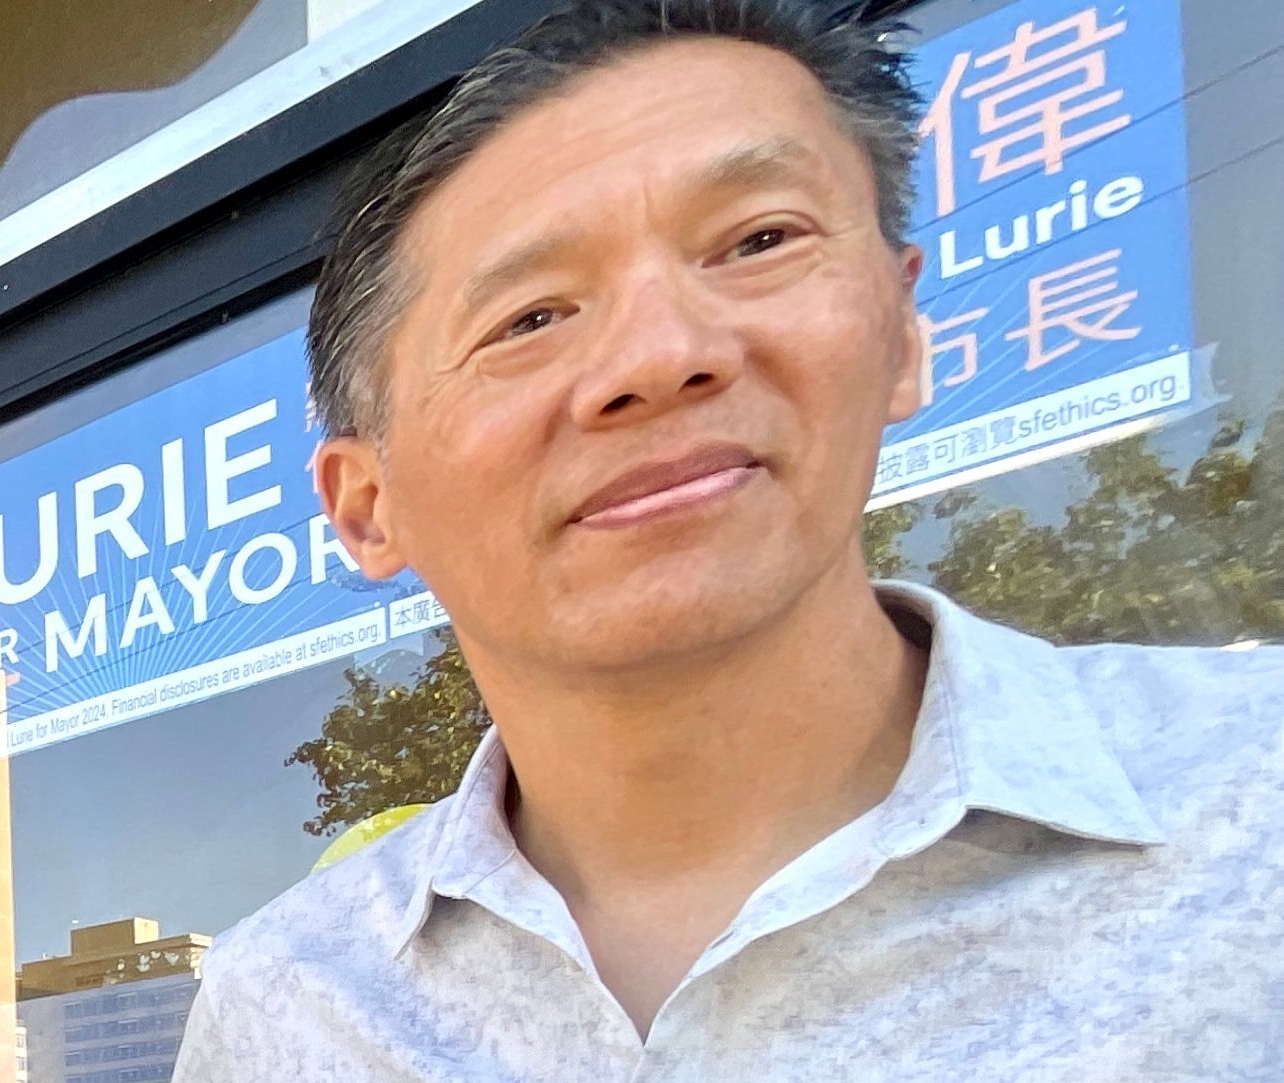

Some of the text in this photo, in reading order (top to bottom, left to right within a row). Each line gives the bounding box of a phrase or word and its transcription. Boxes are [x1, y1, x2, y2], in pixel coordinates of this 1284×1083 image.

[917, 6, 1131, 216] 偉
[939, 175, 1145, 280] Lurie
[43, 513, 361, 673] MAYOR
[10, 728, 34, 747] Lurie
[35, 719, 48, 738] for
[51, 712, 80, 738] Mayor
[111, 691, 158, 716] Financial
[160, 671, 219, 704] disclosures
[222, 667, 240, 684] are
[243, 648, 292, 680] available
[295, 644, 307, 662] at
